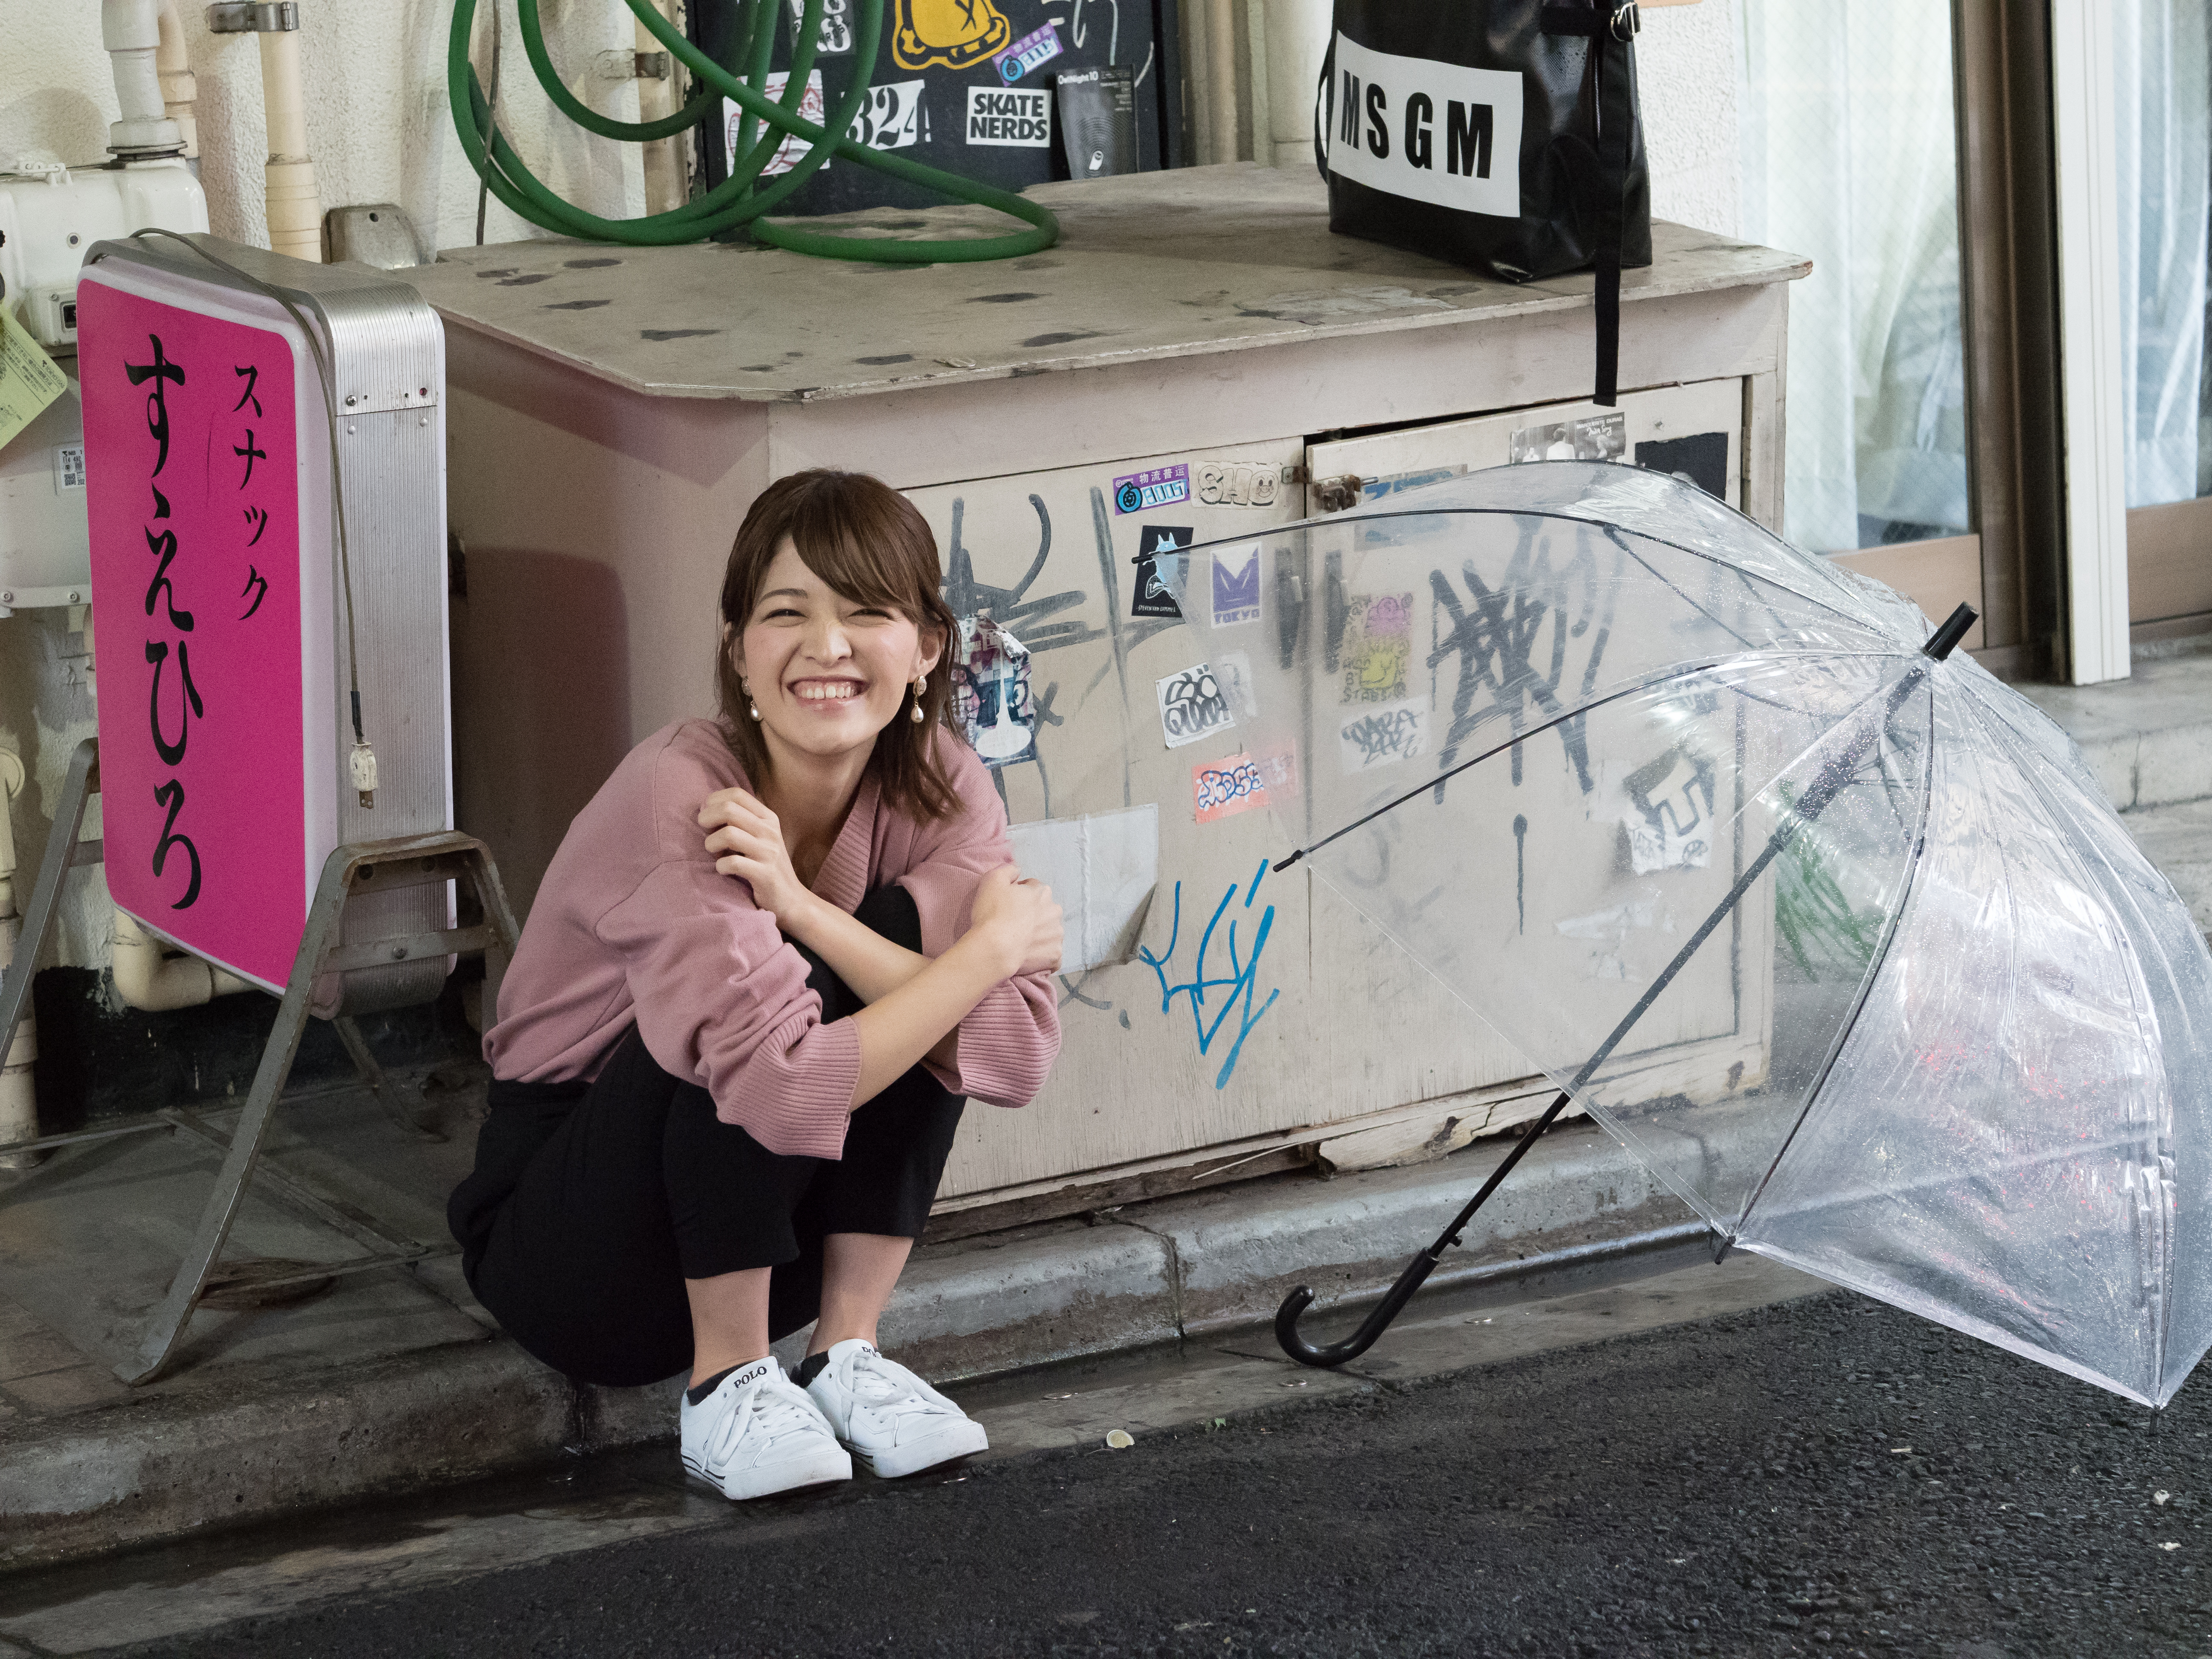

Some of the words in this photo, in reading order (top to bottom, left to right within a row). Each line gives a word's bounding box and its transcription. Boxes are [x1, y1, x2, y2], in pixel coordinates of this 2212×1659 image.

[974, 93, 1044, 118] SKATE
[970, 117, 1048, 140] NERDS
[1340, 69, 1493, 179] MSGM
[1139, 466, 1185, 484] 物流普运
[232, 364, 268, 621] スナック
[124, 334, 204, 910] すえひろ
[1214, 608, 1260, 625] TOKYO
[733, 1366, 767, 1388] POLO
